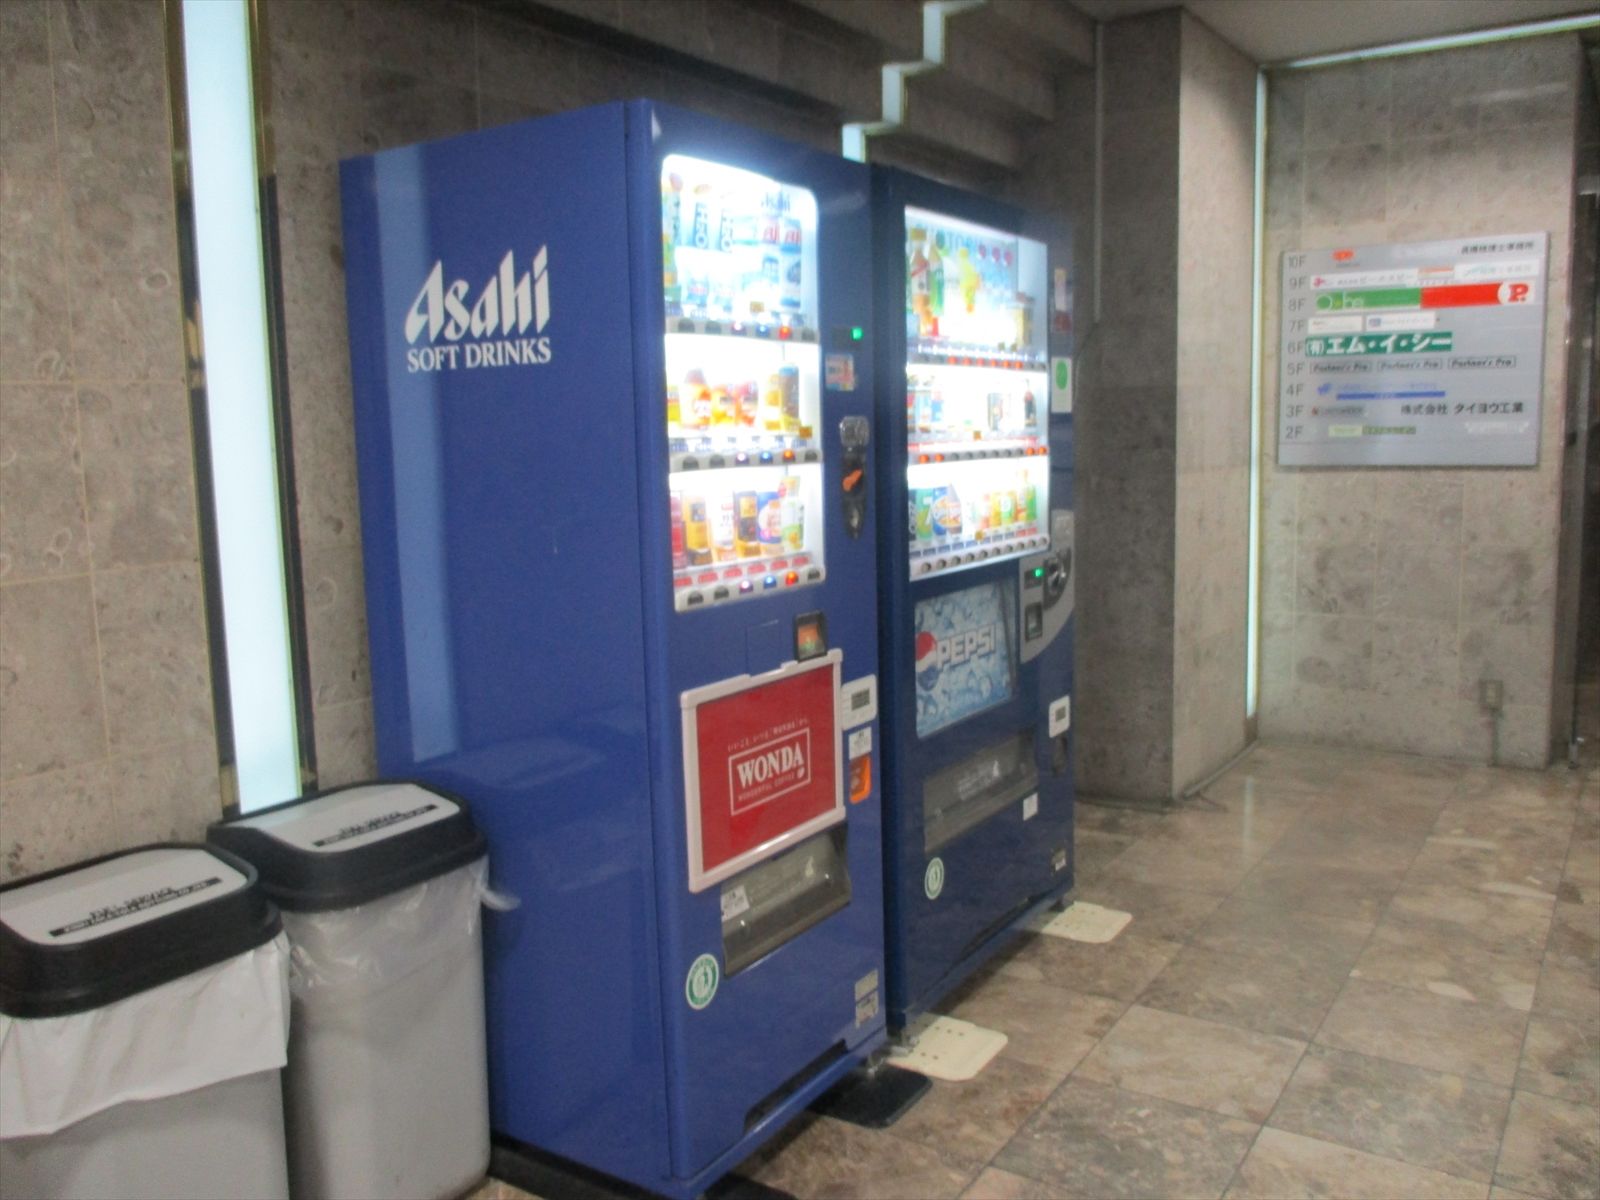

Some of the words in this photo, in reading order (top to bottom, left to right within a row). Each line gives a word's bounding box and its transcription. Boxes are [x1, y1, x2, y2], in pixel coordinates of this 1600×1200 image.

[1288, 255, 1306, 269] 10F
[1289, 276, 1306, 289] 9F
[404, 243, 551, 345] Asahi
[1288, 298, 1305, 311] 8F
[1289, 320, 1305, 333] 7F
[406, 345, 460, 373] SOFT
[464, 337, 552, 369] DRINKS
[1287, 342, 1304, 355] 6F
[1286, 362, 1304, 376] 5F
[1286, 383, 1304, 397] 4F
[1286, 405, 1304, 418] 3F
[1401, 403, 1448, 416] 株式会社
[1453, 401, 1524, 414] タイヨウ工業
[1285, 425, 1303, 440] 2F
[936, 624, 997, 671] PEPSI
[736, 741, 804, 789] WONDA
